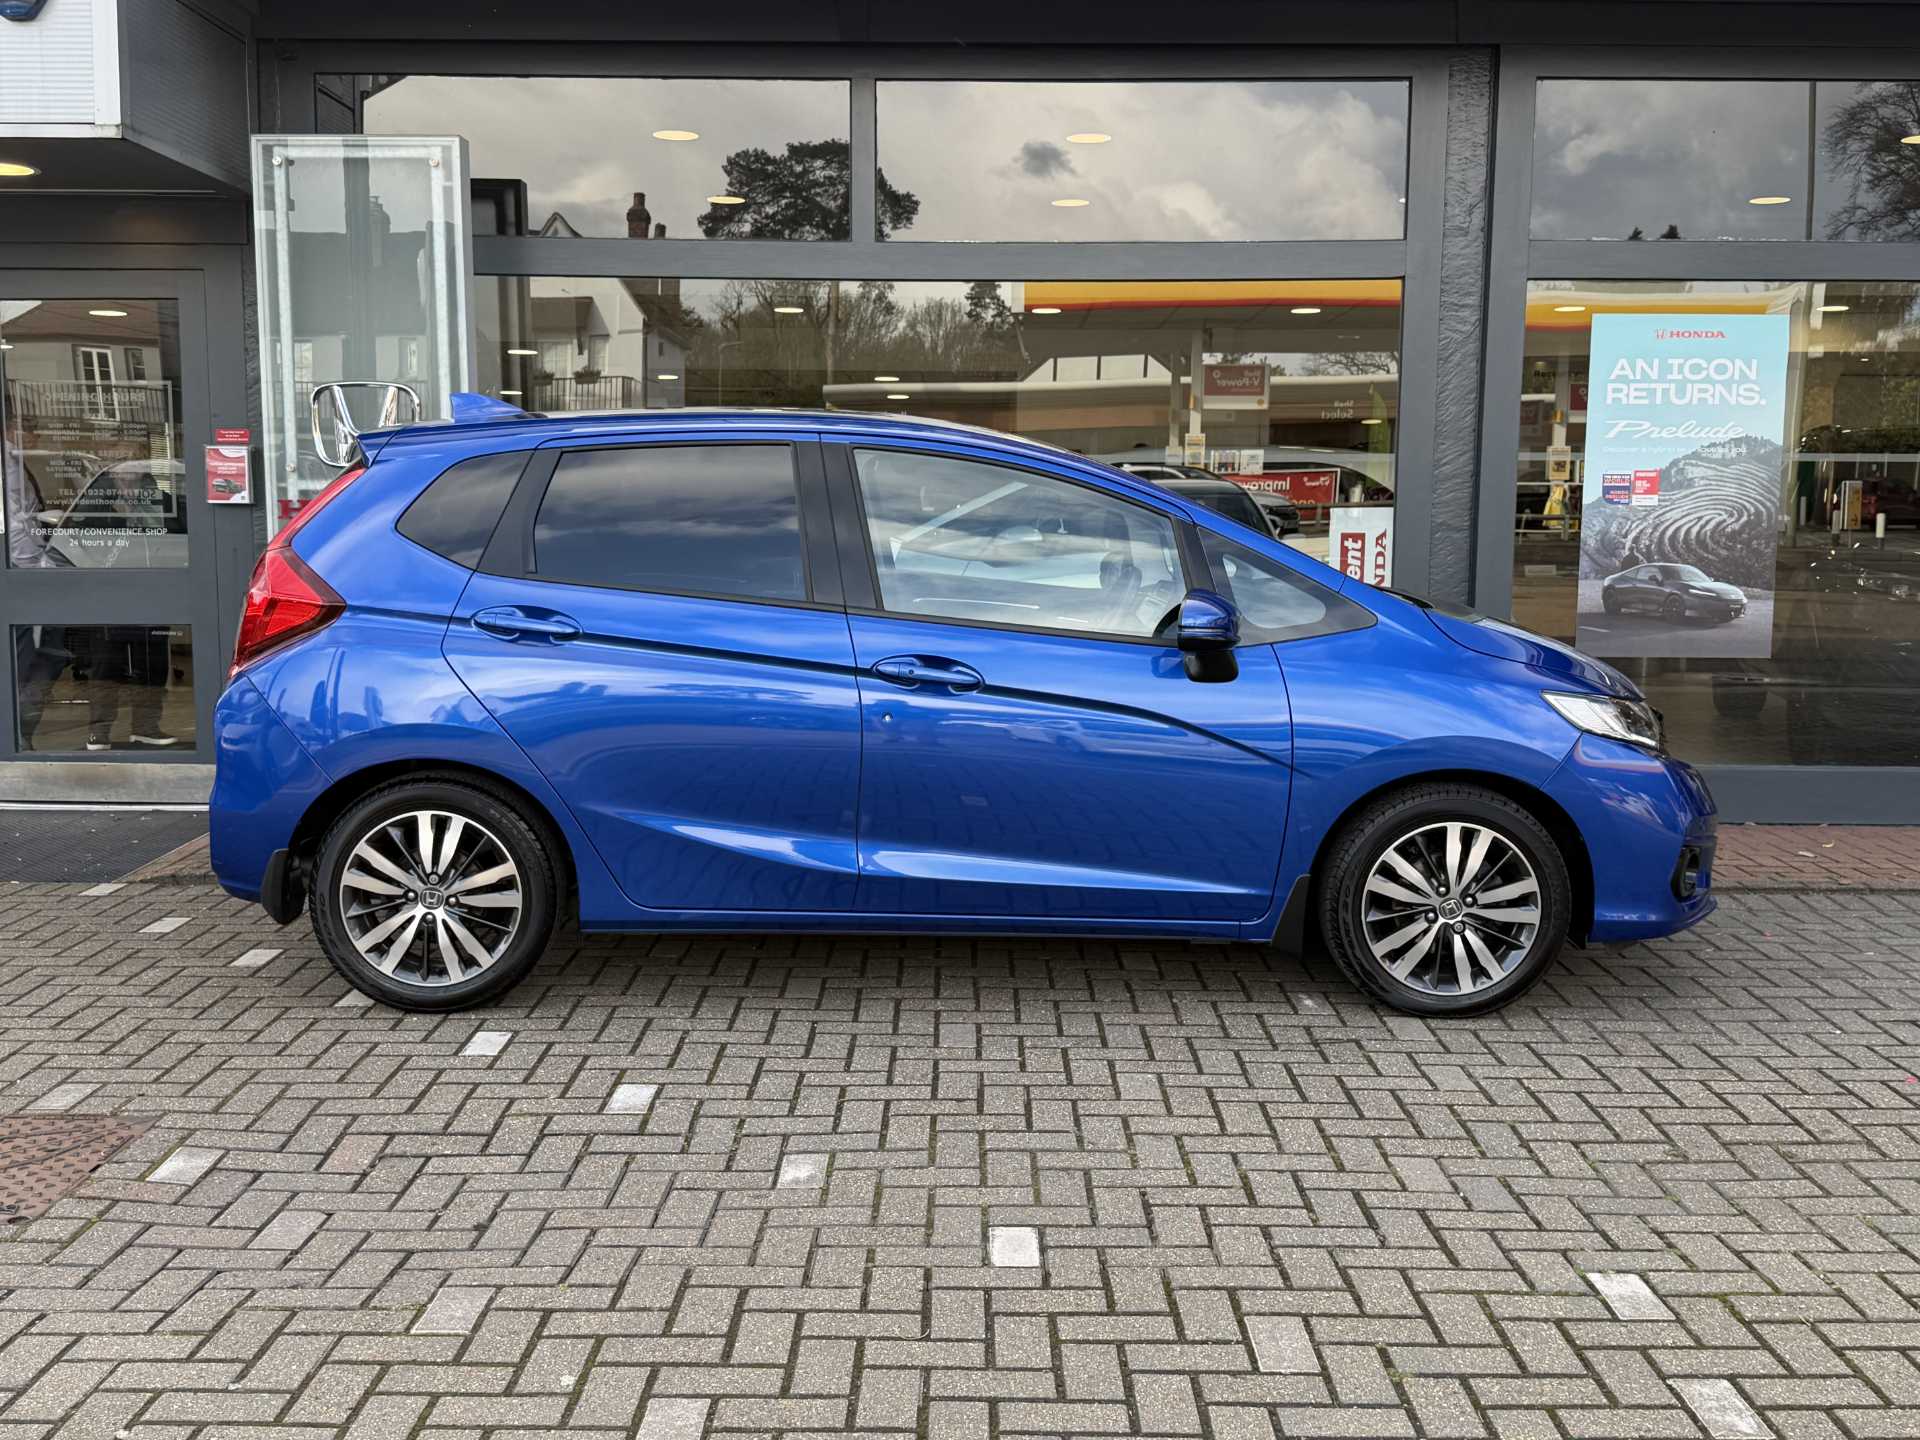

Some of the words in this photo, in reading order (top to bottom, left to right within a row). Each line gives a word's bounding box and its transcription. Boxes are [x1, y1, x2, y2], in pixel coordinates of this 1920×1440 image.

[1669, 330, 1726, 338] HONDA
[1609, 358, 1659, 380] AN
[1667, 358, 1758, 381] ICON
[1605, 383, 1767, 406] RETURNS.
[1604, 420, 1746, 439] Prelude
[146, 528, 168, 536] SHOP
[69, 539, 79, 547] 24
[82, 539, 104, 547] hours
[115, 539, 130, 549] day
